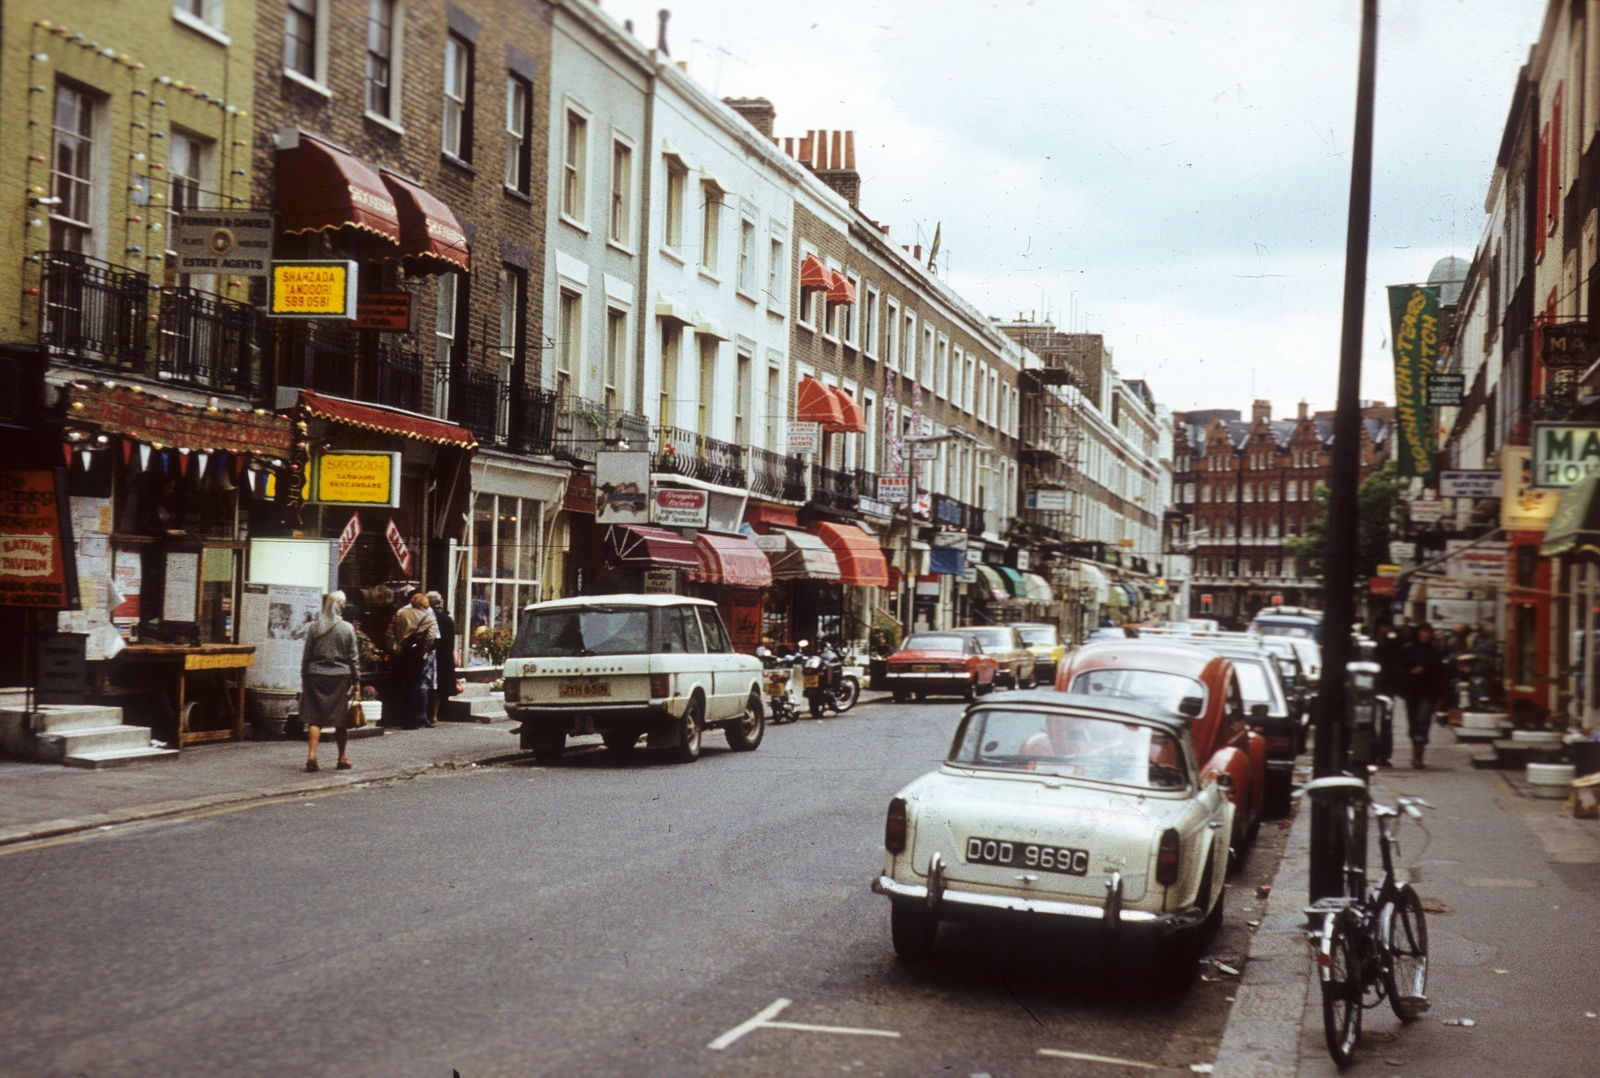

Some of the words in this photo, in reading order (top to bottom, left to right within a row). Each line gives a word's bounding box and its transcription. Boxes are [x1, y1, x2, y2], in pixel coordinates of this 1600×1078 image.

[183, 257, 218, 267] ESTATE
[222, 258, 263, 270] AGENTS
[284, 284, 332, 296] TANDOORI
[1546, 430, 1600, 461] MA
[881, 478, 909, 486] ABRE
[660, 508, 700, 517] International
[2, 538, 49, 557] EATING
[2, 557, 48, 571] TAVERN
[522, 664, 537, 674] GB
[967, 838, 1014, 864] DOD
[1025, 845, 1088, 872] 969C
